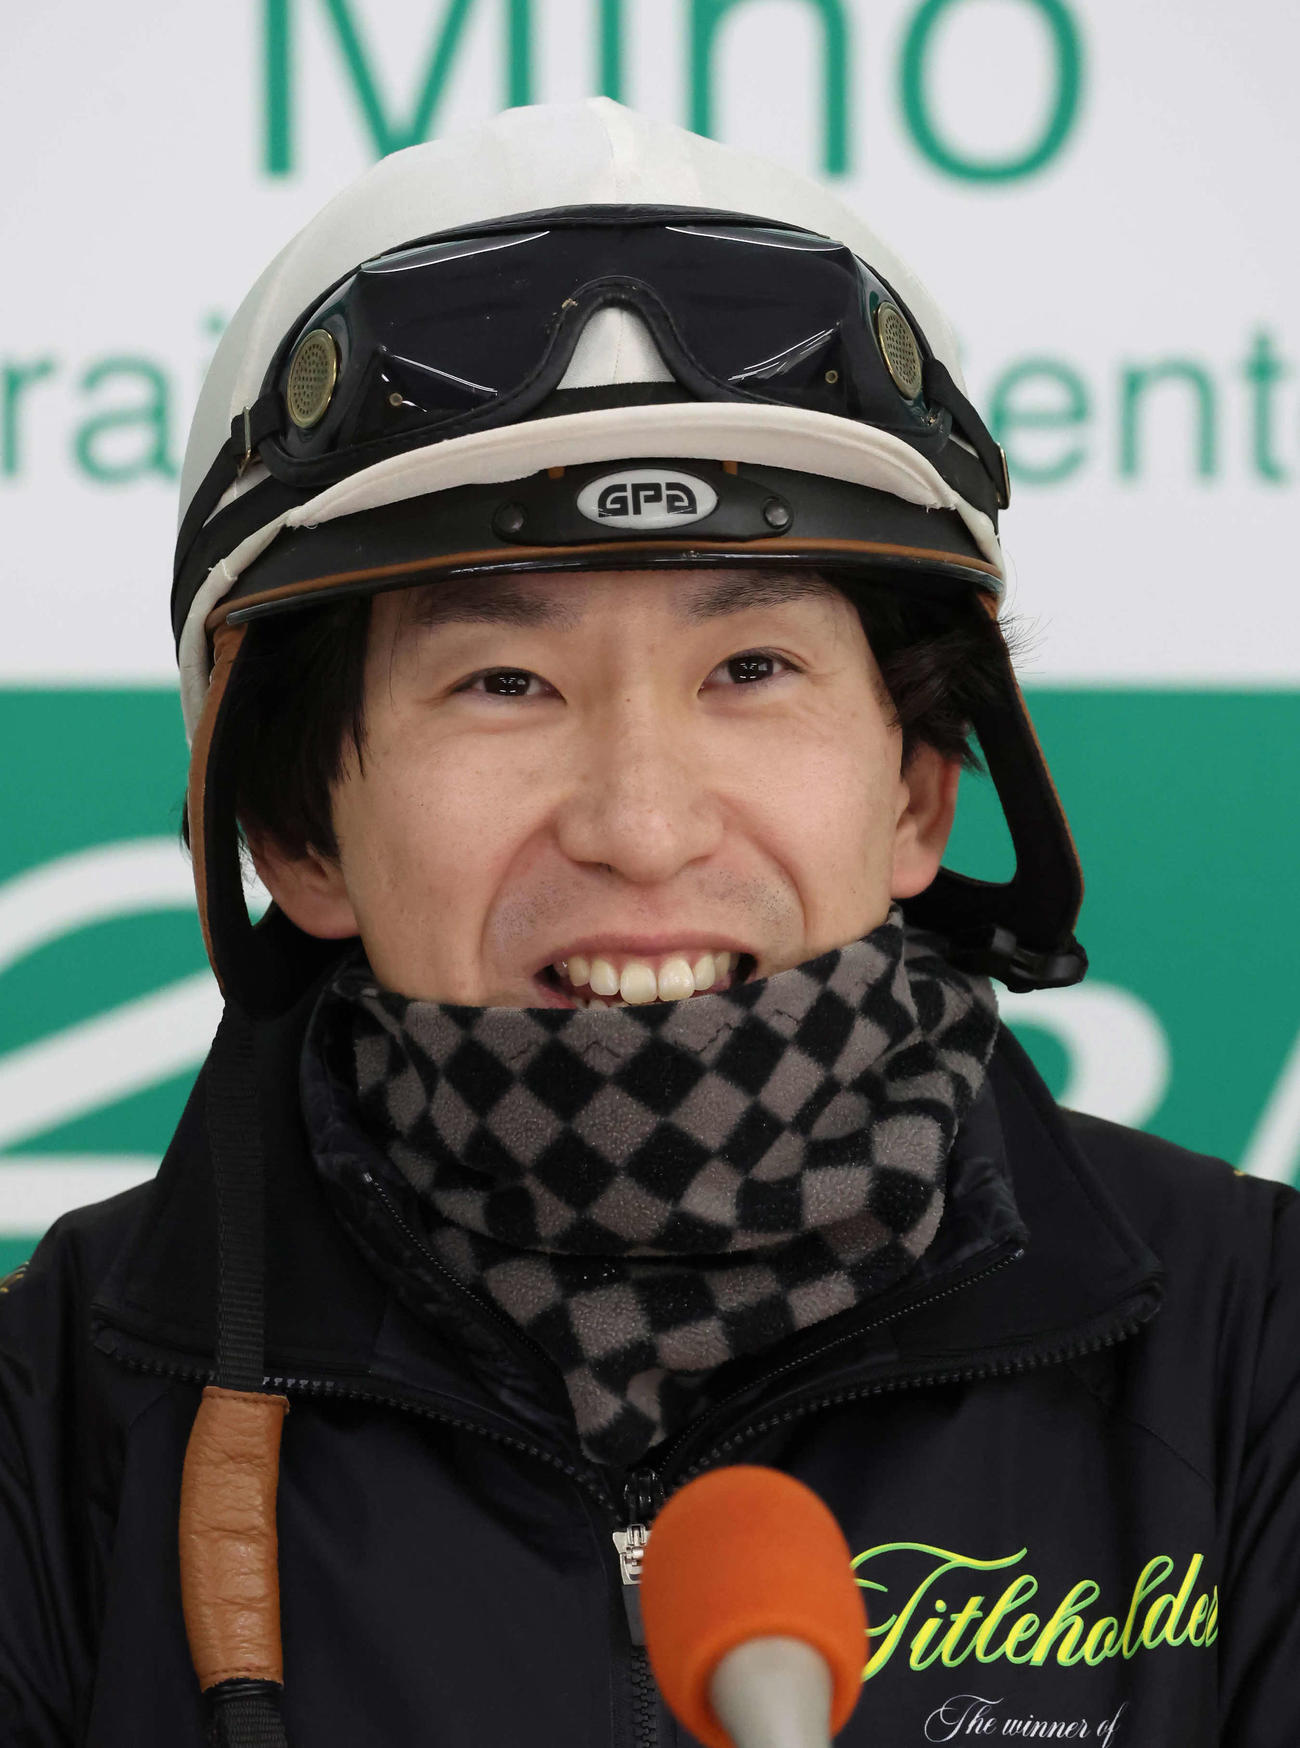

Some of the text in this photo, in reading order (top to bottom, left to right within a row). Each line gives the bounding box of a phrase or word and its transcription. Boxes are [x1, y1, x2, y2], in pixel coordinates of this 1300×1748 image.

[0, 312, 1300, 486] ra ent
[924, 1694, 1129, 1748] The winner of
